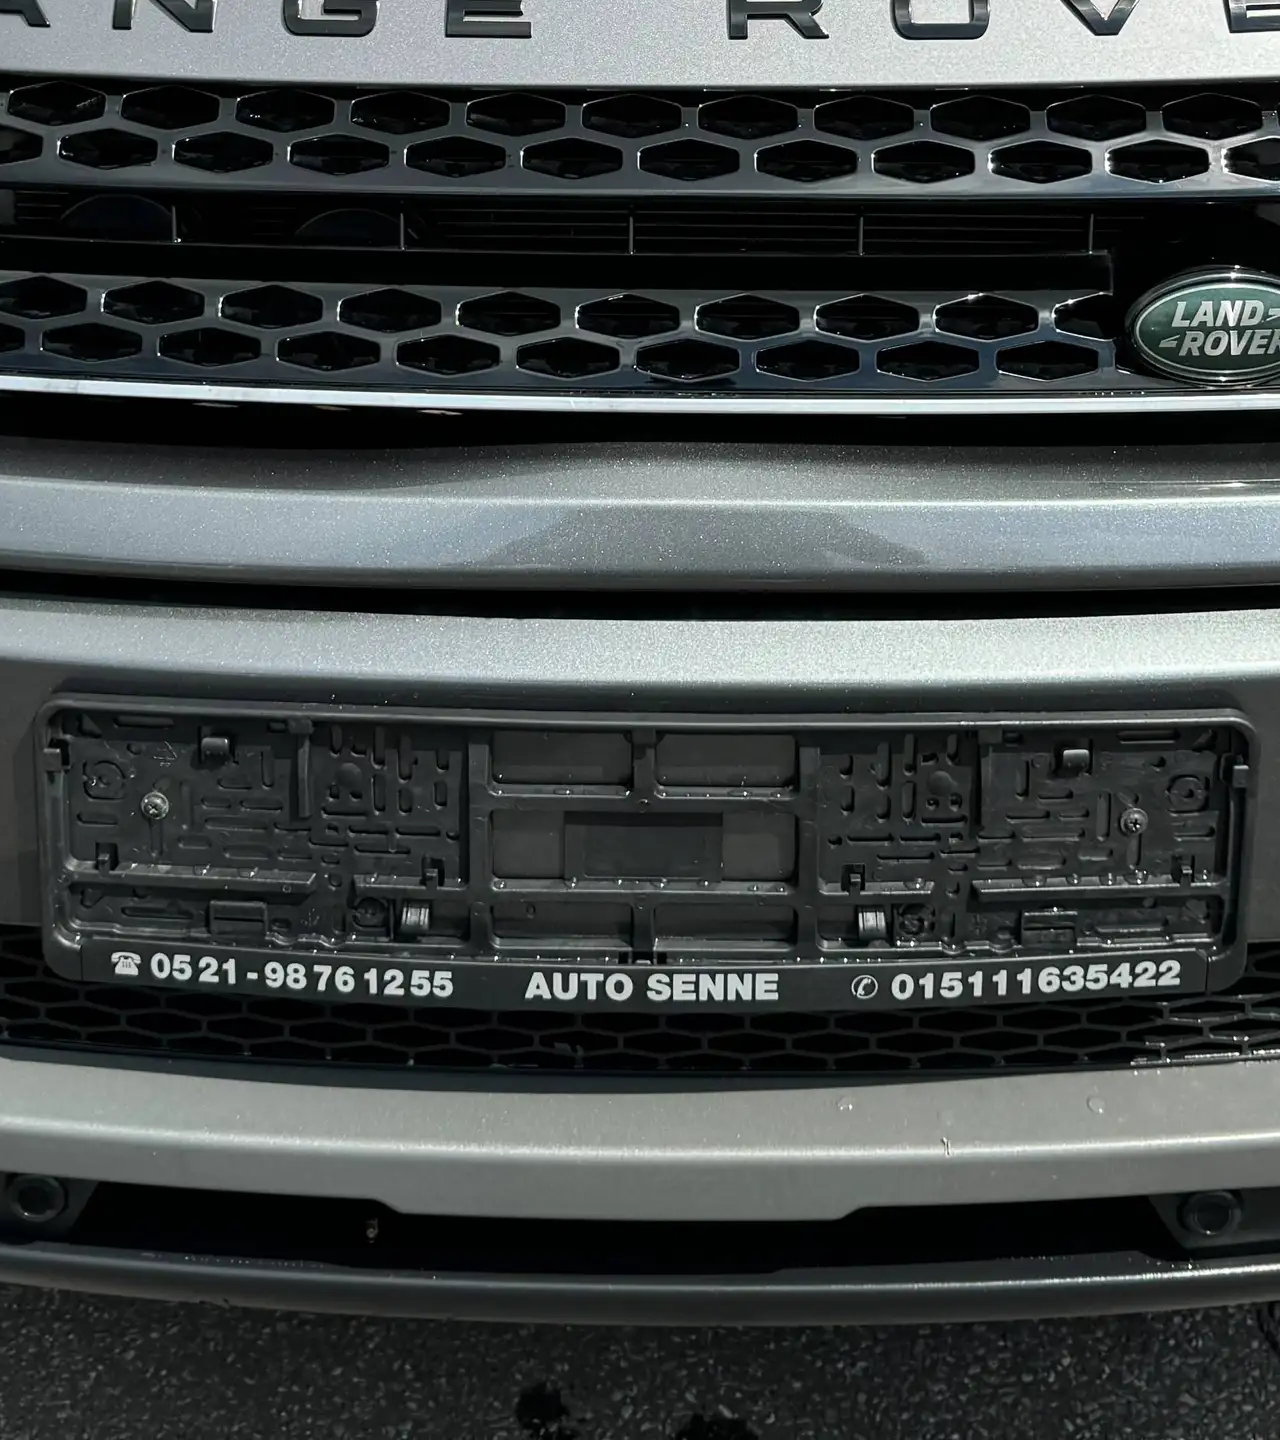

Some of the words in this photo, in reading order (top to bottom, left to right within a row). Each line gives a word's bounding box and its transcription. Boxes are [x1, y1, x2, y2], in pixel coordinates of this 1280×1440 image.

[1171, 300, 1265, 327] LAND
[524, 971, 634, 1001] AUTO
[646, 972, 779, 1001] SENNE
[891, 960, 1181, 1000] 015111635422
